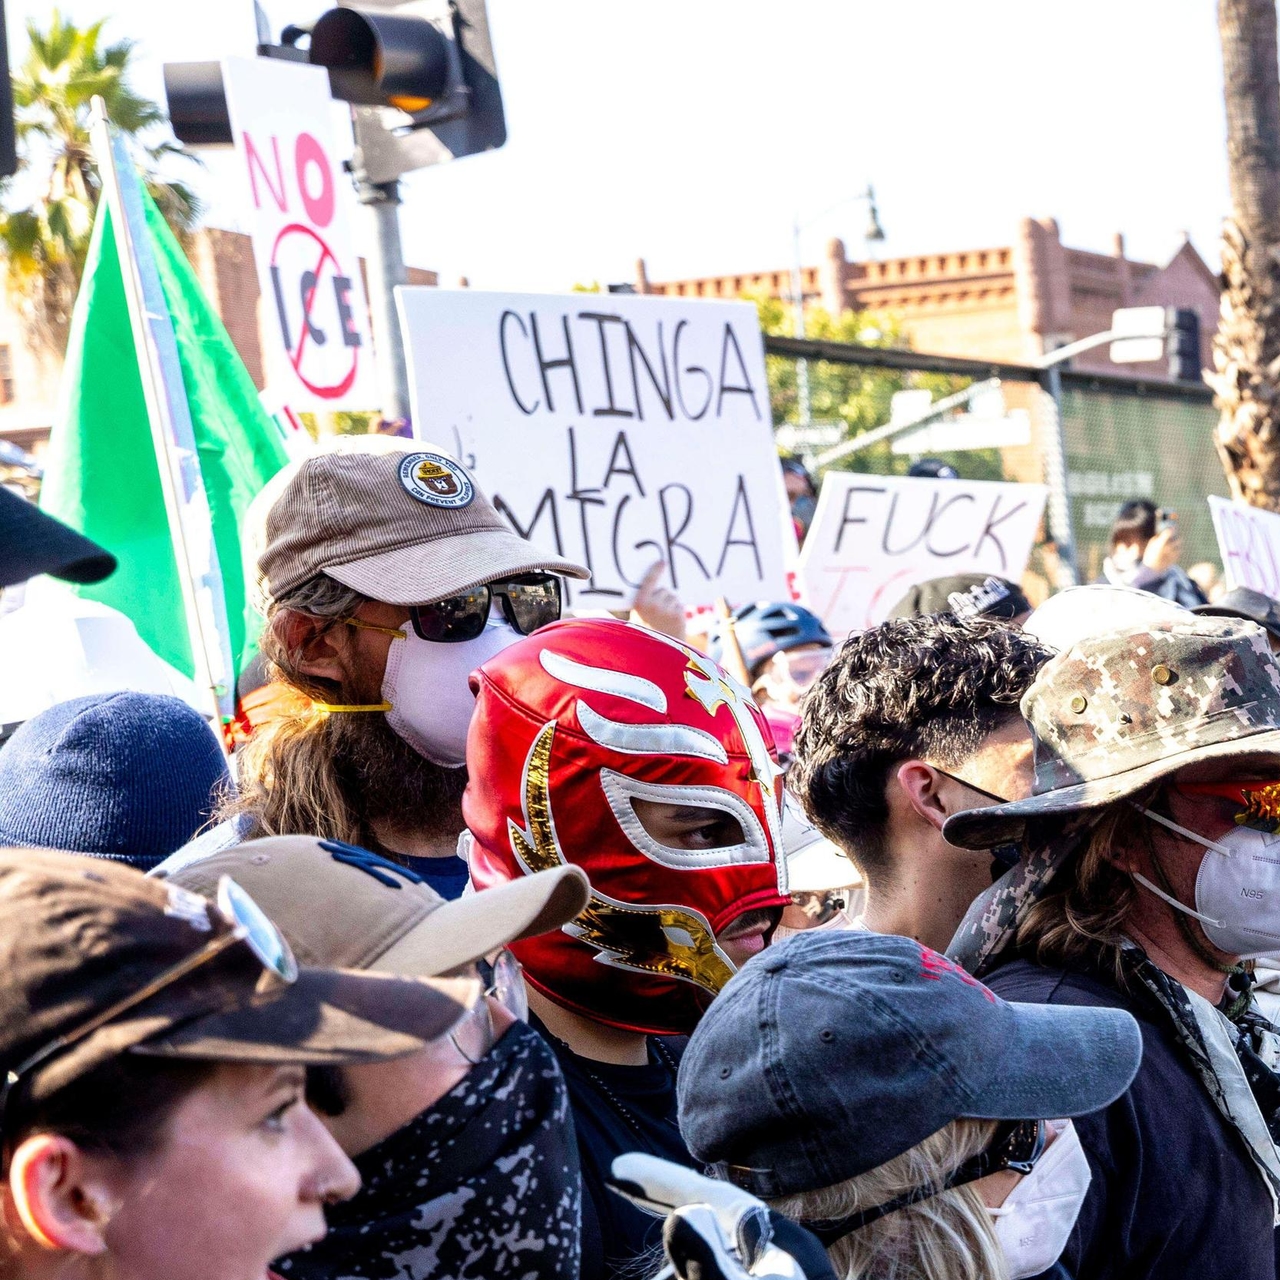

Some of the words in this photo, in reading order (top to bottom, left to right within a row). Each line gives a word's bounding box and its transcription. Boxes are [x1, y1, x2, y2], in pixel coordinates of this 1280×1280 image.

[242, 131, 336, 228] NO
[269, 266, 363, 351] ICE
[499, 310, 763, 422] CHINGA
[411, 487, 425, 498] CAN
[426, 495, 458, 506] PREVENT
[566, 426, 646, 498] LA
[491, 474, 764, 607] MIGRA
[832, 485, 1029, 572] FUCK
[1240, 887, 1265, 900] N95
